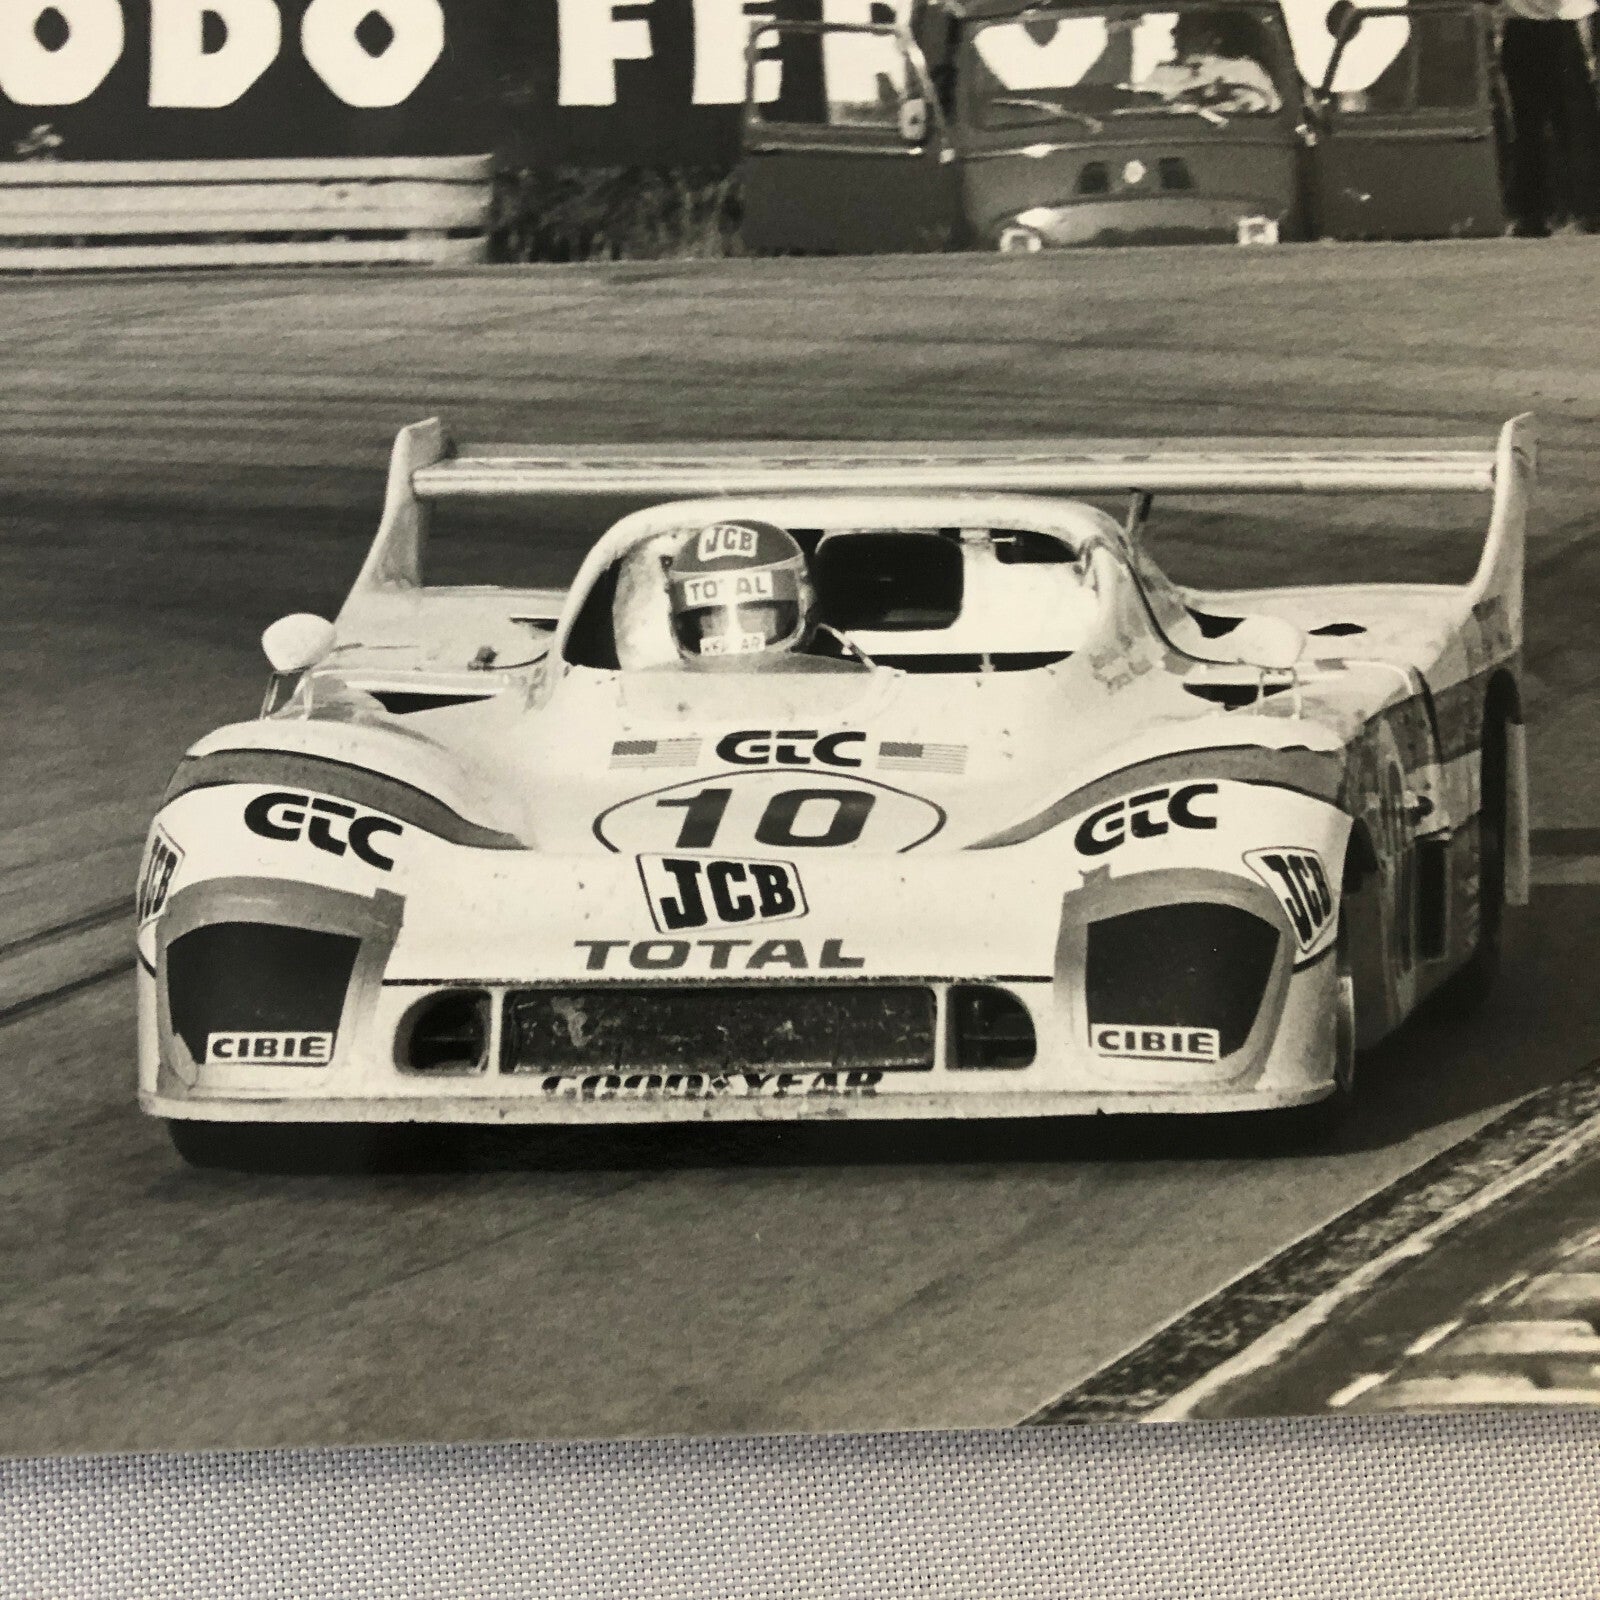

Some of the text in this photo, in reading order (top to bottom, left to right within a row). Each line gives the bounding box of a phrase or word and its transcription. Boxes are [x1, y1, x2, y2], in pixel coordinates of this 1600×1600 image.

[705, 526, 754, 554] JCB
[689, 576, 768, 601] TOAL
[656, 788, 876, 848] 10
[659, 858, 796, 930] JCB
[1261, 854, 1332, 943] JCB
[573, 939, 866, 971] TOTAL
[212, 1036, 326, 1058] CIBIE
[1097, 1030, 1214, 1055] CIBIE
